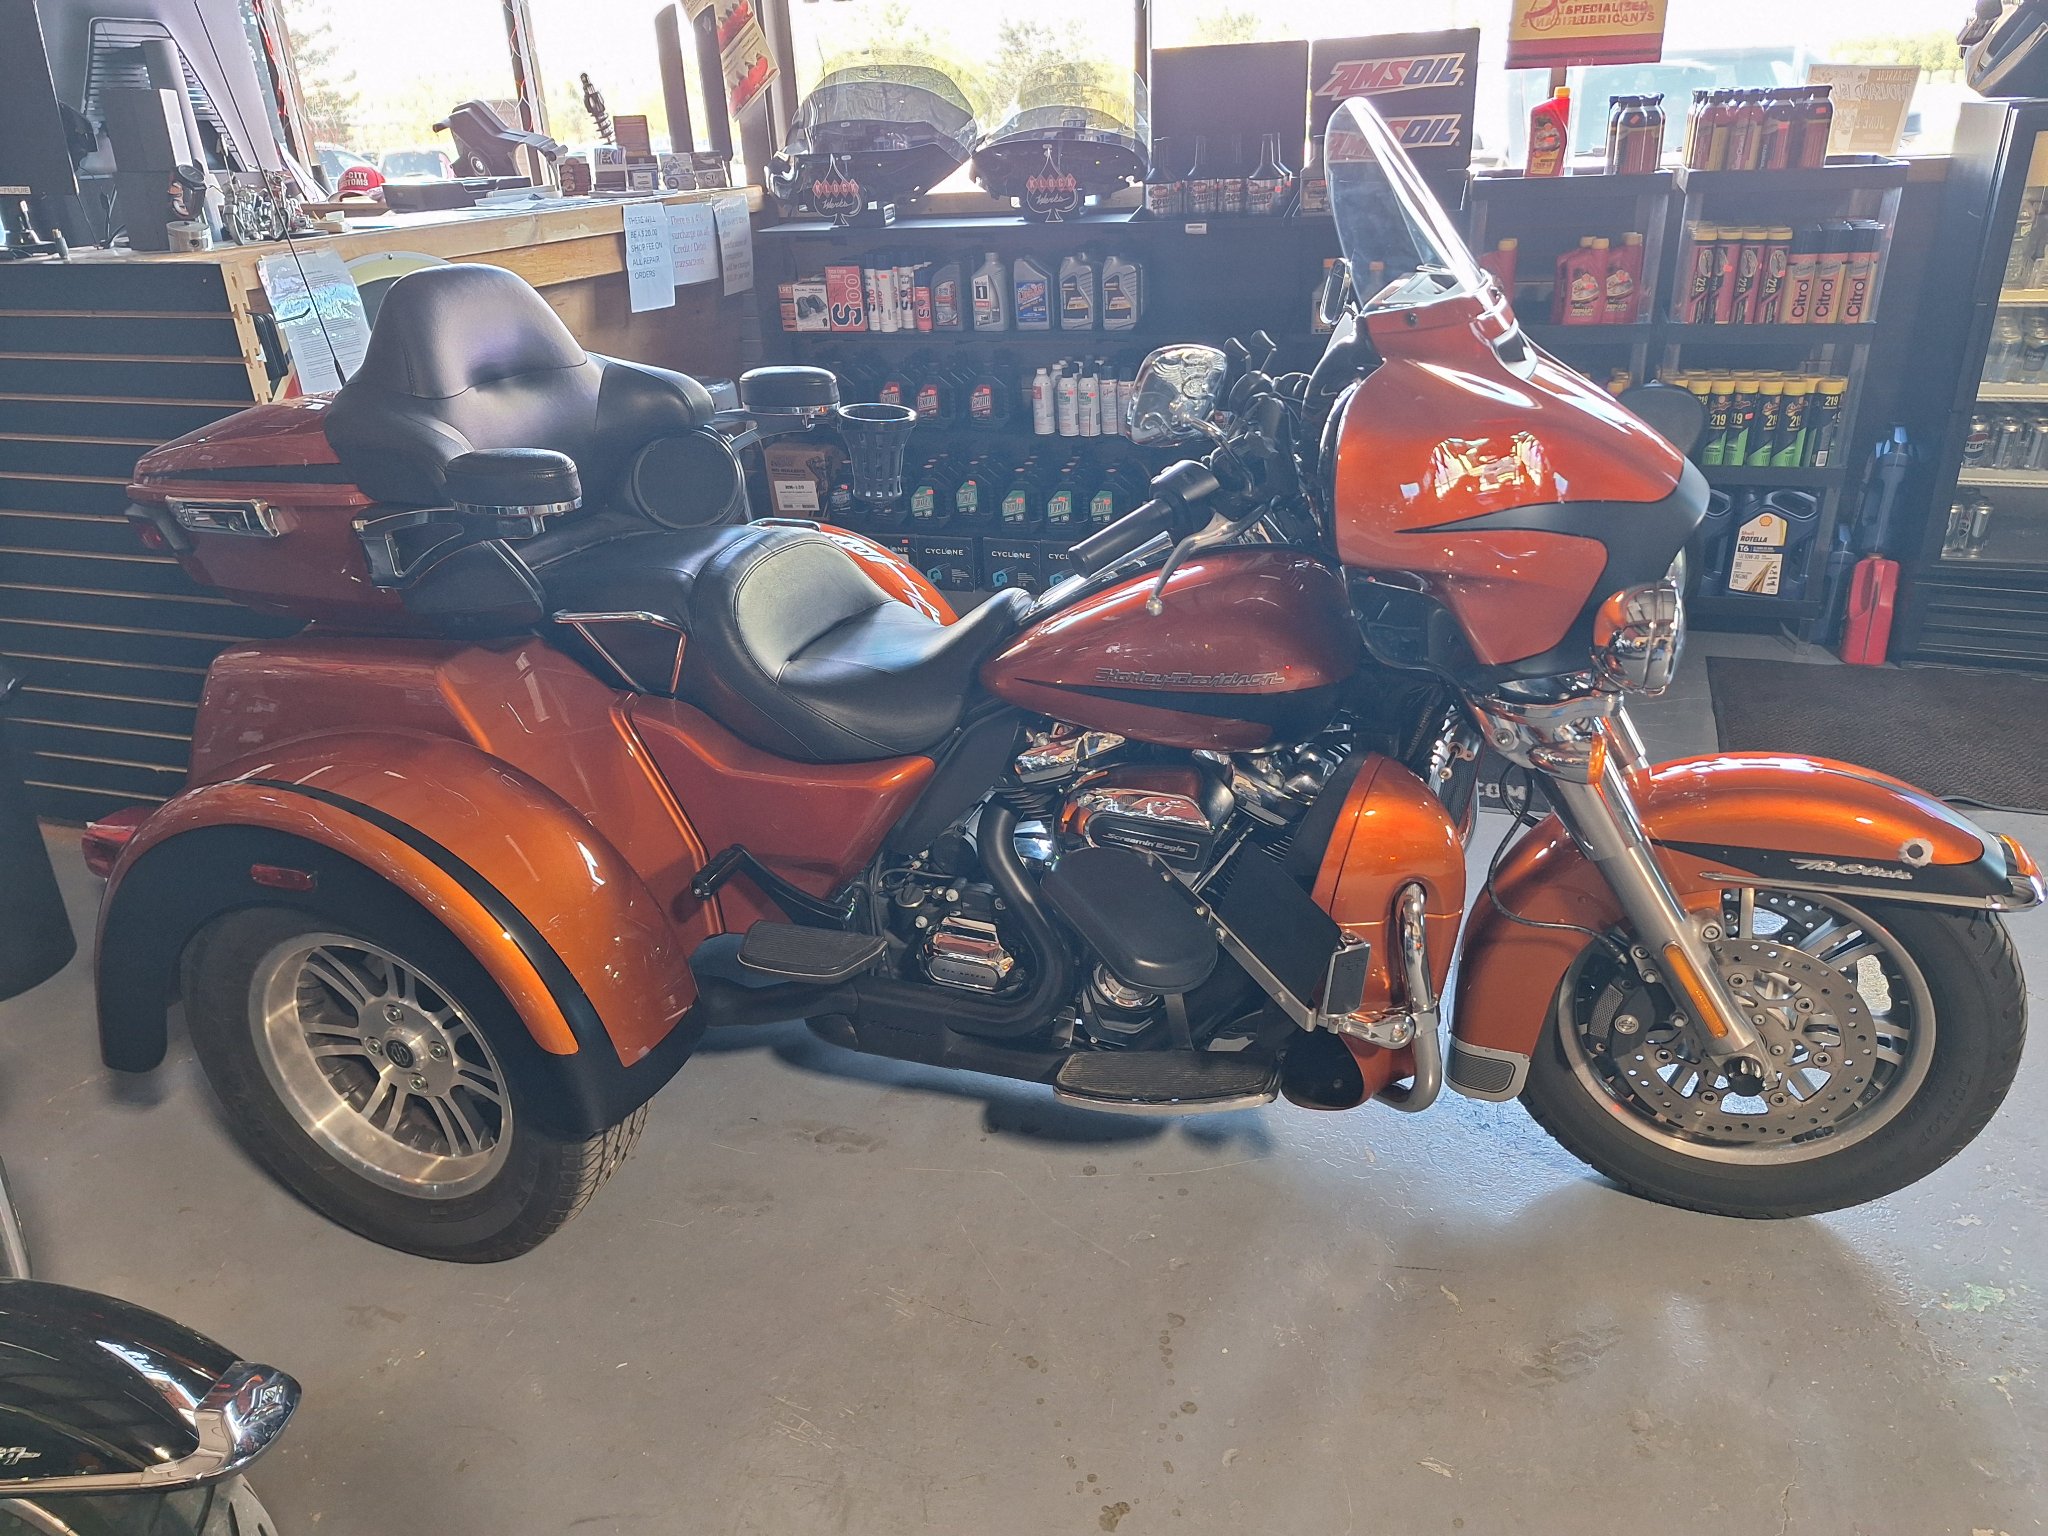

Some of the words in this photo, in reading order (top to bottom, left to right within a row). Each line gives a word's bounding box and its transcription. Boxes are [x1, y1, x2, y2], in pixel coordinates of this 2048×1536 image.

[1566, 1, 1649, 14] SPECIALIZED
[1572, 11, 1656, 25] LUBRICANTS
[1318, 54, 1463, 99] AMSOIL
[814, 180, 858, 195] KLOCK
[1028, 176, 1075, 190] KLOCK
[822, 197, 853, 210] Werks
[1035, 194, 1070, 204] Werks
[628, 216, 643, 225] THERE
[630, 244, 645, 253] SHOP
[643, 256, 660, 265] REPAIR
[634, 270, 656, 279] ORDERS
[1695, 277, 1706, 293] 229
[1765, 277, 1778, 293] 229
[831, 273, 863, 326] S100
[1792, 279, 1809, 317] Citrol
[1815, 279, 1834, 317] Citrol
[1847, 278, 1866, 317] Citrol
[1825, 396, 1839, 406] 219
[1710, 414, 1727, 426] 219
[1740, 535, 1768, 543] ROTELLA
[925, 547, 964, 556] CYCLONE
[991, 551, 1031, 559] CYCLONE
[1094, 667, 1286, 690] Harley-Davidson
[1102, 832, 1155, 848] Screamin'
[1155, 842, 1188, 853] Eagle
